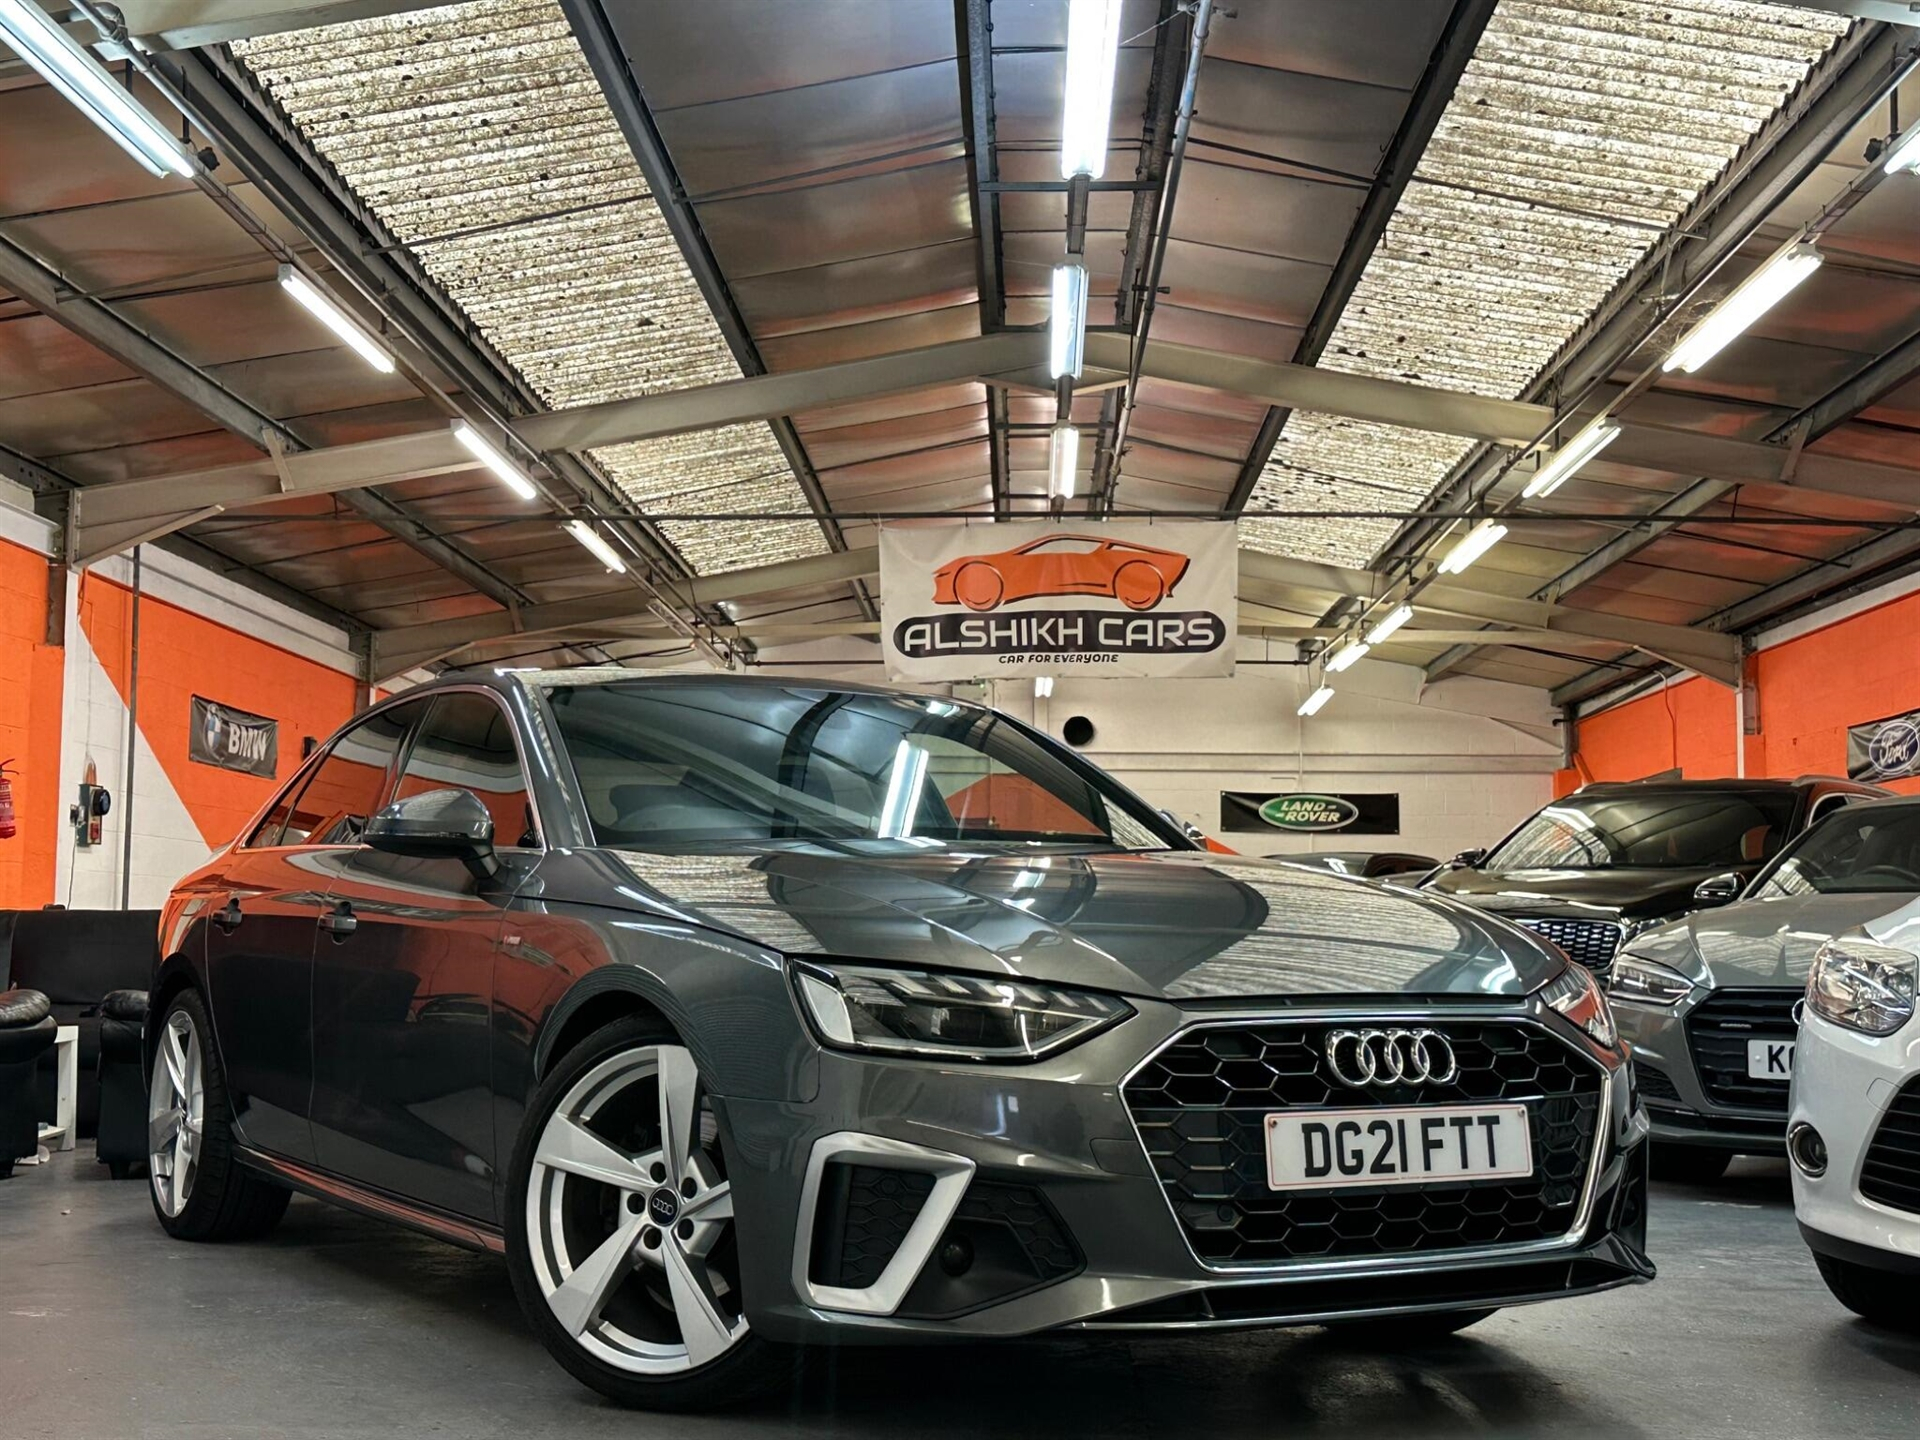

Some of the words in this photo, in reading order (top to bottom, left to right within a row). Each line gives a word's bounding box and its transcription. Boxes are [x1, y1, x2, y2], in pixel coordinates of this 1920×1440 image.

[904, 617, 1083, 652] ALSHIKH
[1098, 617, 1215, 647] CARS
[998, 655, 1025, 664] CAR
[1028, 654, 1051, 663] FOR
[1053, 654, 1119, 664] EVERYONE
[228, 722, 267, 761] BMW
[1880, 731, 1910, 767] Ford
[1301, 1119, 1408, 1177] DG21
[1420, 1115, 1500, 1171] FTT
